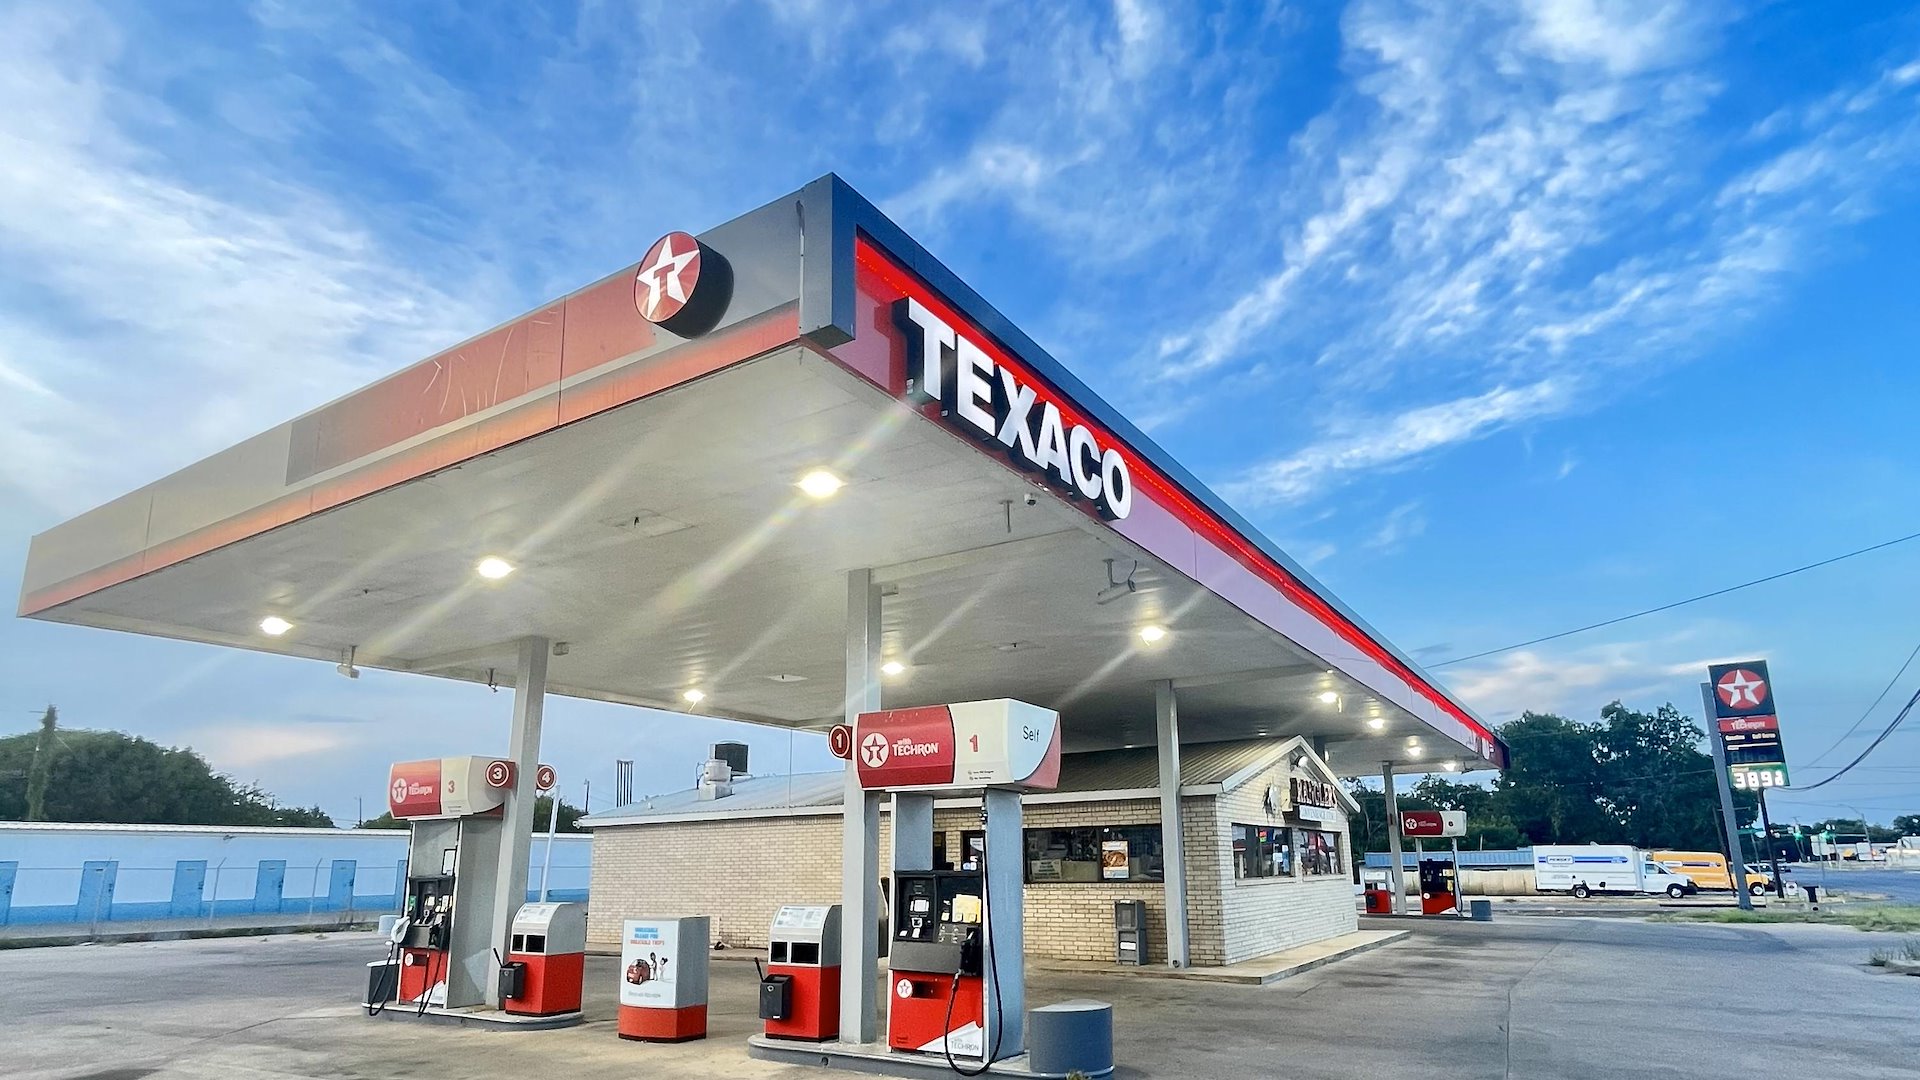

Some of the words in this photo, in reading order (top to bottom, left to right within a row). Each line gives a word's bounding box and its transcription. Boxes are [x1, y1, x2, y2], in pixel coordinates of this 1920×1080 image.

[908, 296, 1132, 520] TEXACO
[836, 733, 842, 749] 1
[896, 737, 912, 745] with
[1022, 725, 1040, 742] Self
[892, 742, 939, 757] TECHRON
[969, 734, 979, 753] 1
[492, 767, 503, 780] 3
[541, 771, 551, 783] 4
[448, 780, 455, 793] 3
